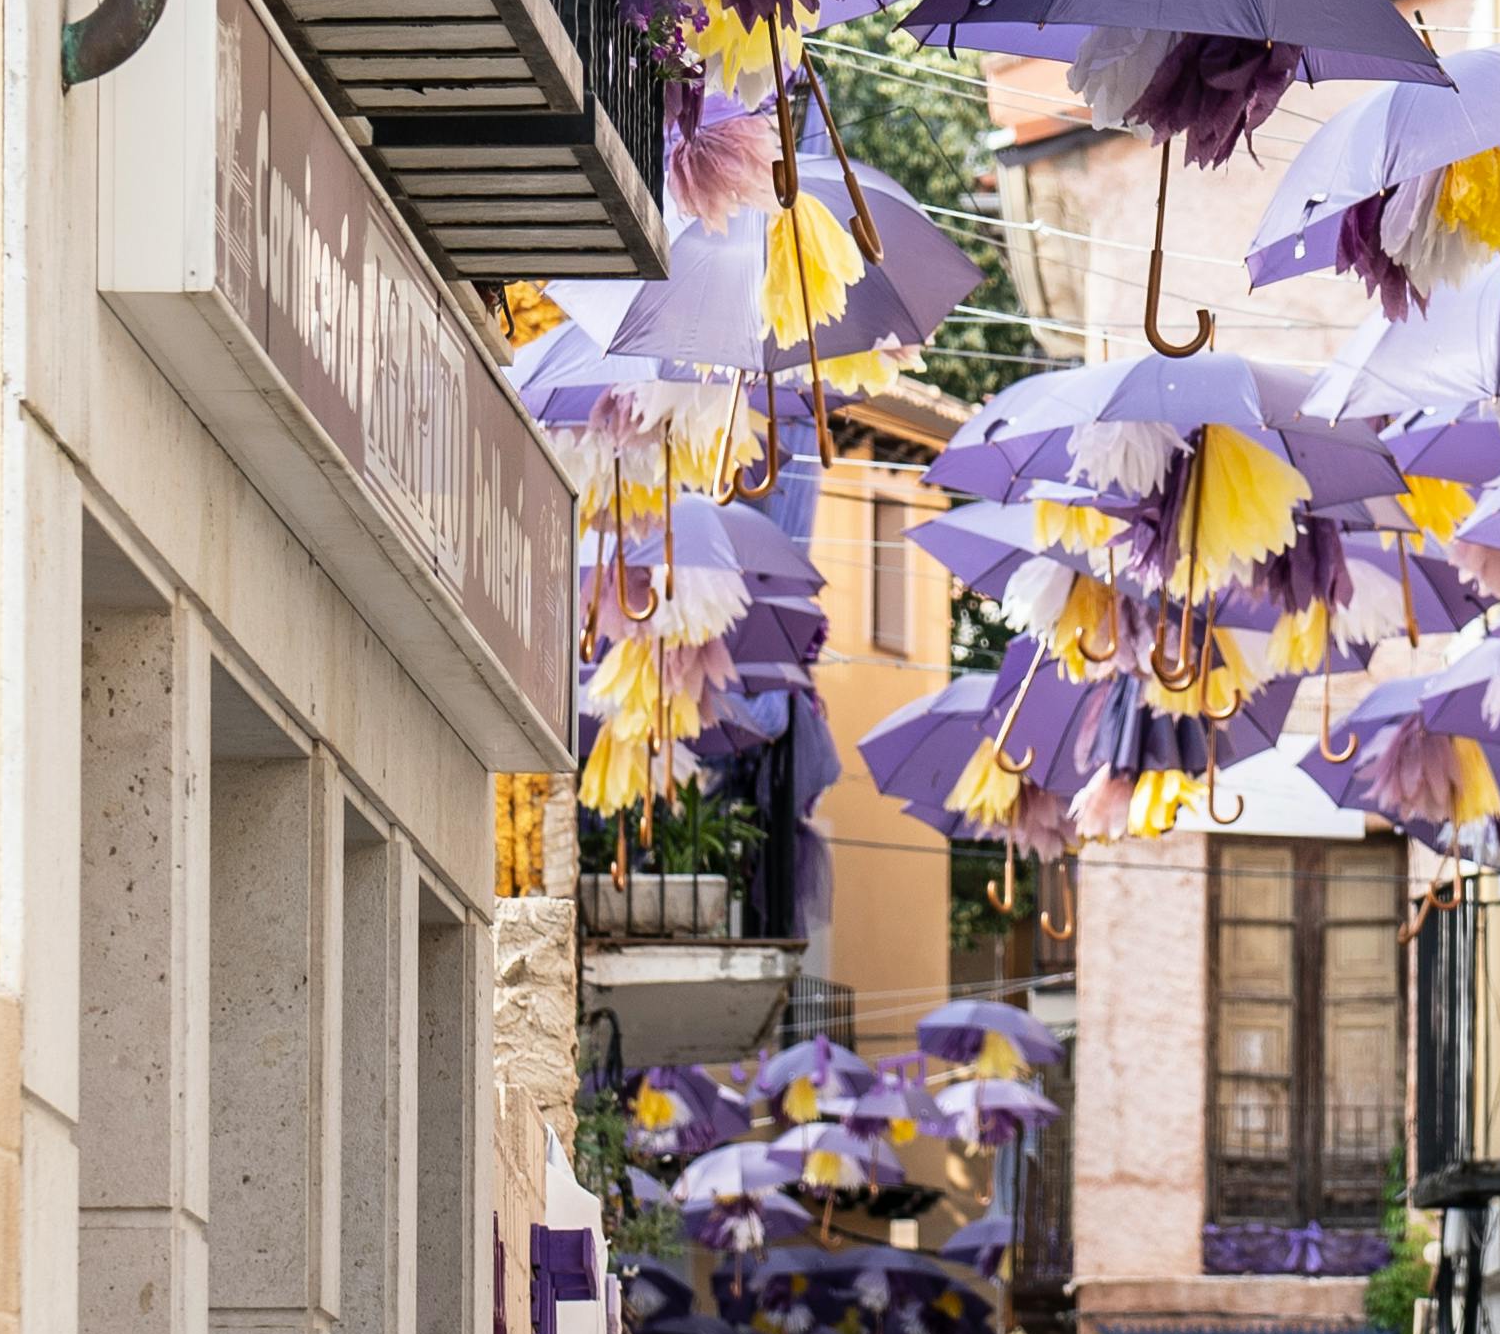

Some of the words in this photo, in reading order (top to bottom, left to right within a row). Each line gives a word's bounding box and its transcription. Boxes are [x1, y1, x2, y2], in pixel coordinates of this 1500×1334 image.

[255, 109, 360, 415] Carnicería
[367, 250, 465, 567] AGAPITO
[473, 427, 533, 651] Pollería
